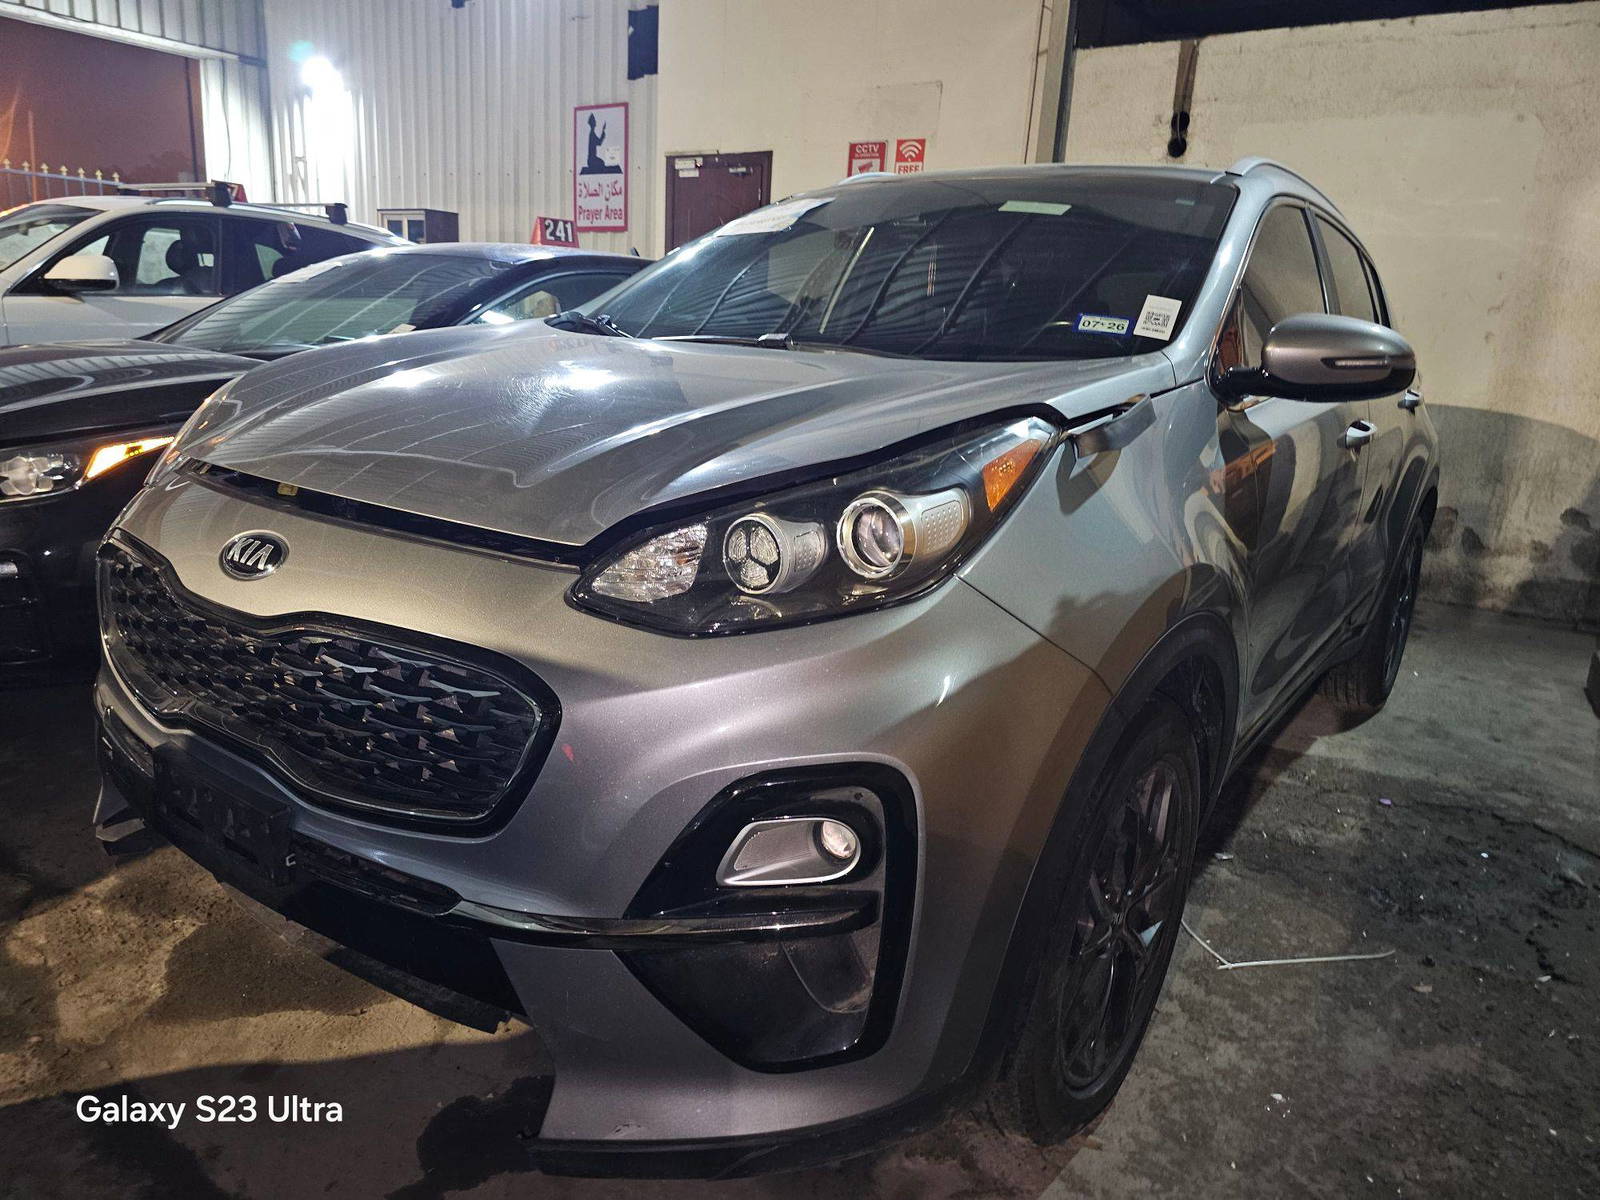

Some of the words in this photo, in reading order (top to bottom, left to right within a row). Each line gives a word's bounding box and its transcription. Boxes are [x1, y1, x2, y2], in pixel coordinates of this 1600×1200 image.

[855, 144, 879, 153] CCTV
[898, 165, 919, 174] FREE
[578, 181, 603, 199] الصلاة
[604, 180, 623, 202] مكان
[578, 205, 603, 224] Prayer
[604, 205, 623, 220] Area
[544, 219, 573, 242] 241
[227, 538, 274, 570] KIA
